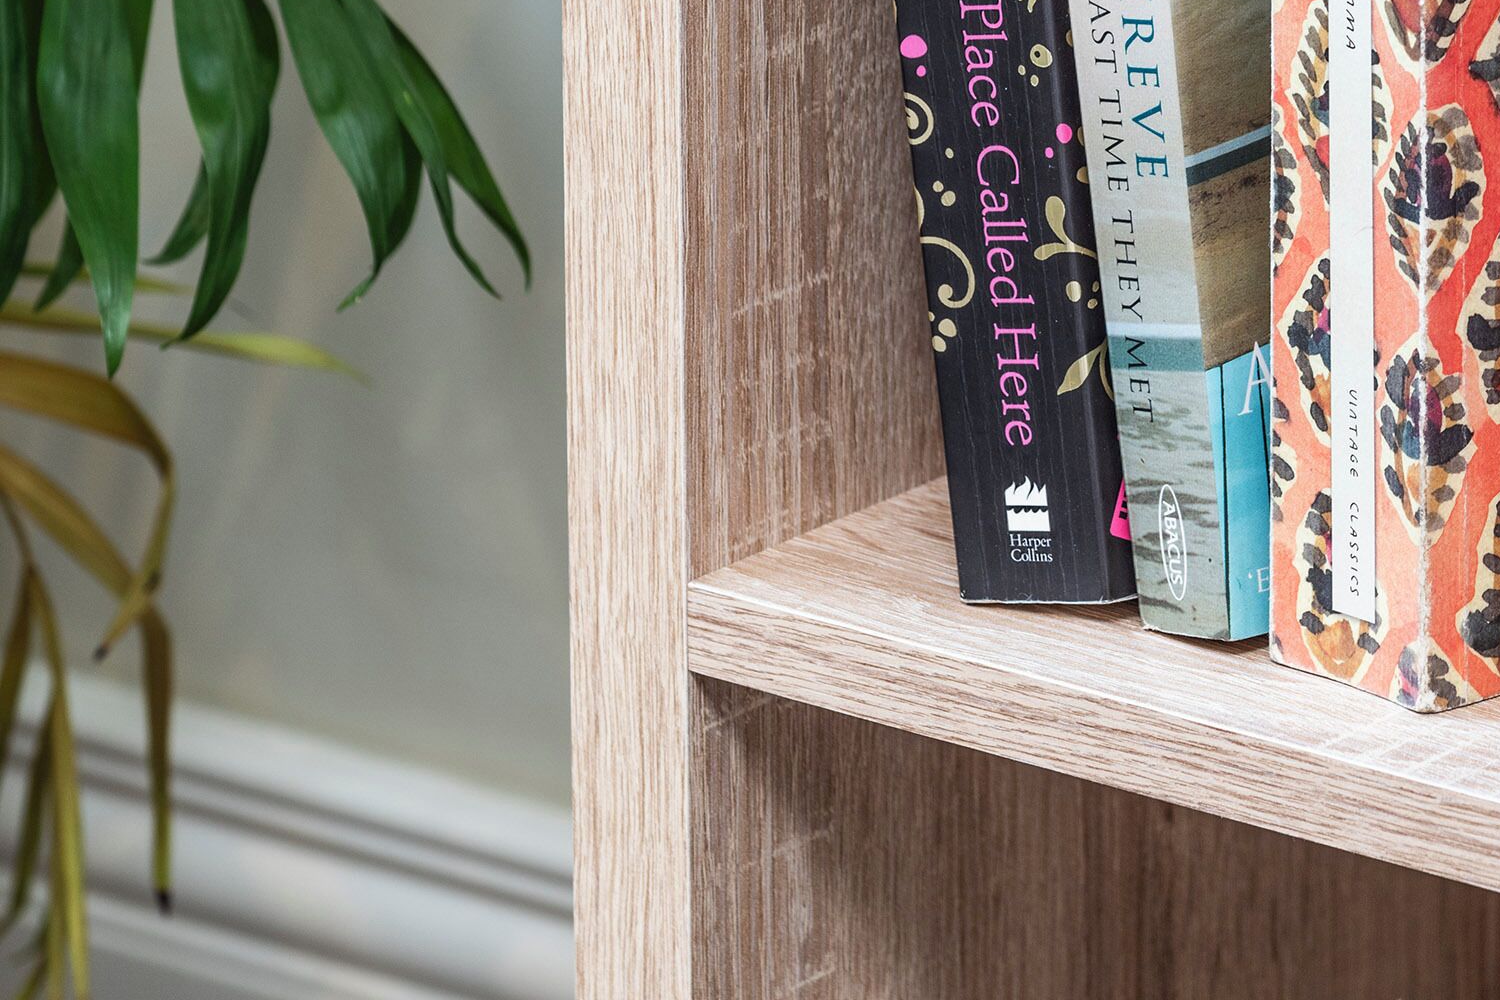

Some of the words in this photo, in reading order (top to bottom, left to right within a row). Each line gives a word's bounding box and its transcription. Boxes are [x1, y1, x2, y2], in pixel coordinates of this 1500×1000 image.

[1098, 90, 1129, 191] TIME
[976, 145, 1035, 307] Called
[1111, 209, 1143, 322] THEY
[993, 322, 1039, 447] Here
[1127, 336, 1155, 422] MET
[1349, 389, 1359, 477] VINTAGE
[1009, 533, 1052, 548] Harper
[1011, 548, 1054, 563] Collins
[1162, 500, 1184, 586] ABACUS
[1349, 501, 1360, 596] CLASSICS
